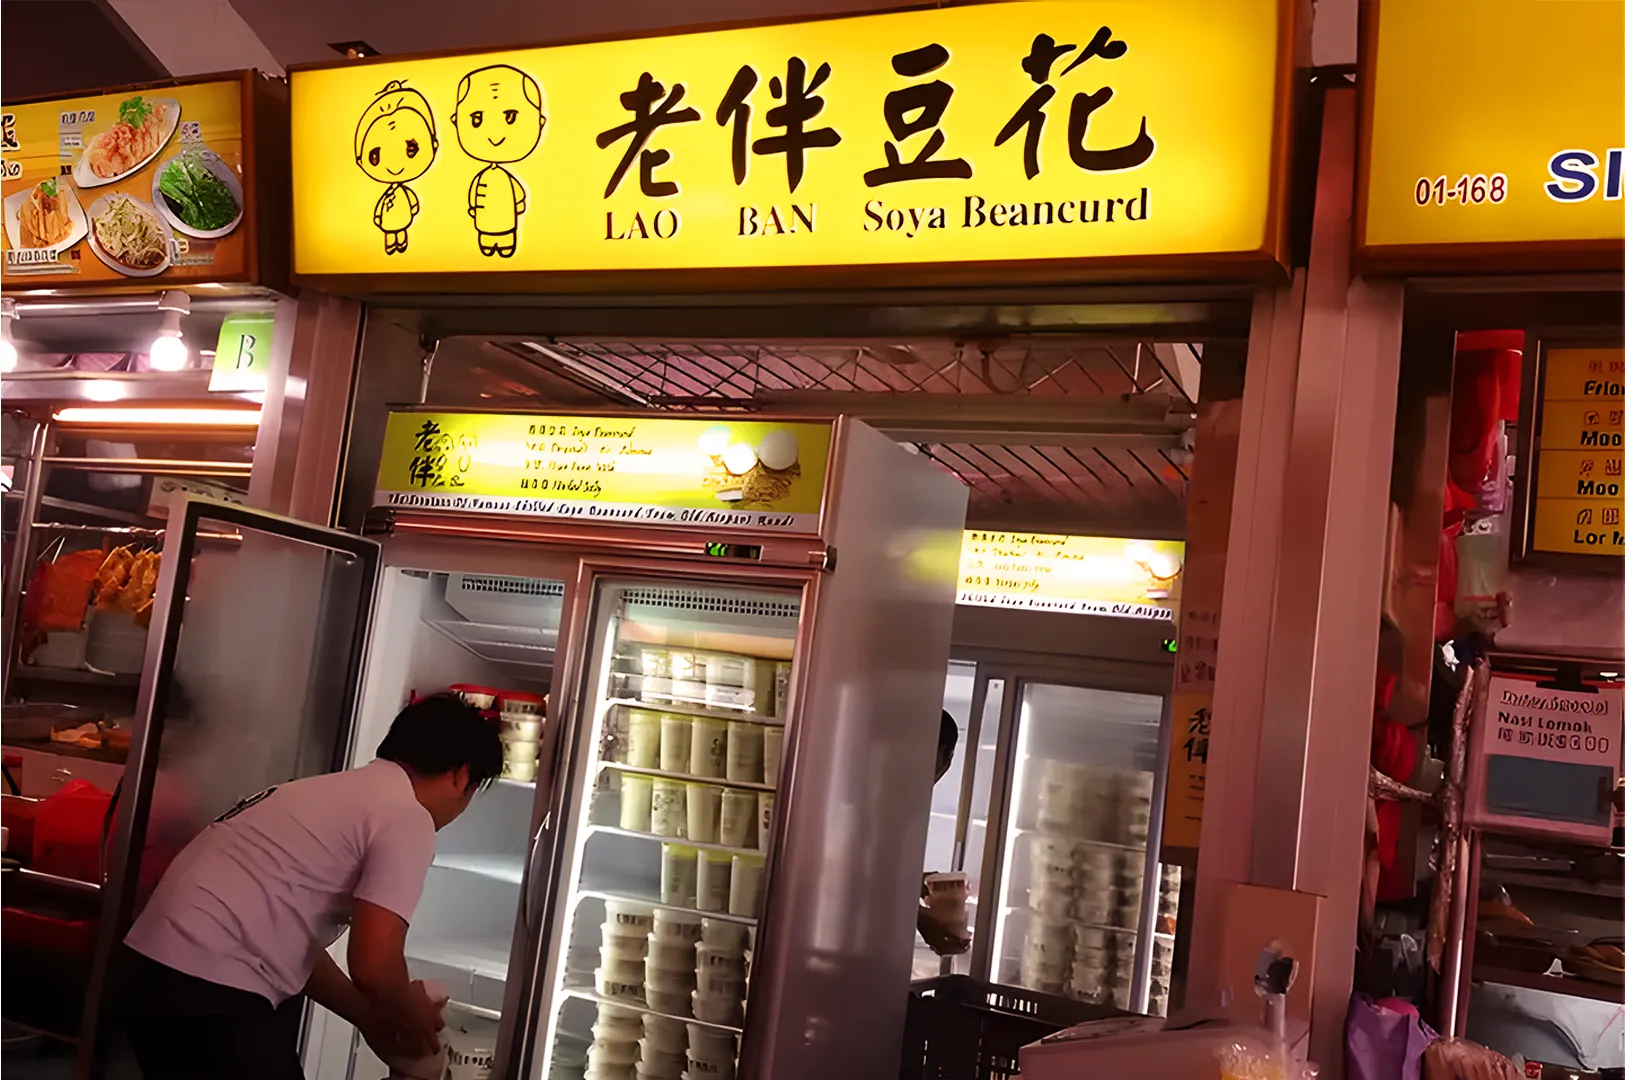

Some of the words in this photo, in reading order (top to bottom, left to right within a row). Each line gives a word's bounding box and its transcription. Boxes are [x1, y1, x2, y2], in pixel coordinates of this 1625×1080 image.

[595, 25, 1155, 200] 老伴豆花
[1415, 175, 1506, 206] 01-168
[603, 210, 679, 241] LAO
[737, 203, 815, 237] BAN
[863, 199, 947, 238] Soya
[962, 188, 1148, 229] Beancurd
[236, 334, 256, 369] B
[1574, 530, 1606, 545] Lor
